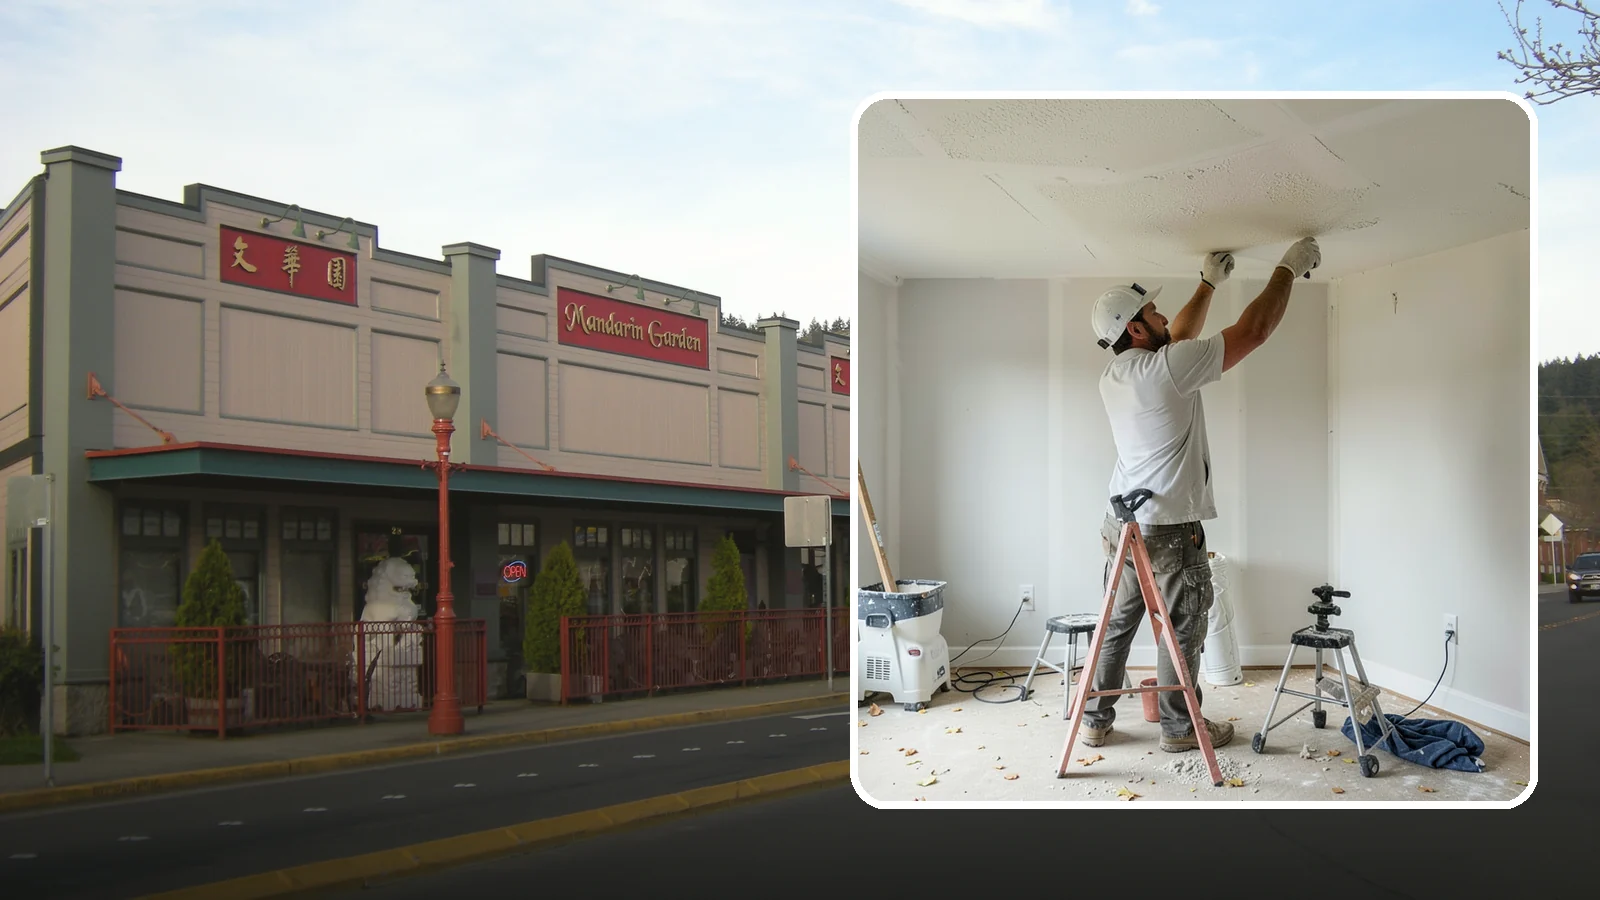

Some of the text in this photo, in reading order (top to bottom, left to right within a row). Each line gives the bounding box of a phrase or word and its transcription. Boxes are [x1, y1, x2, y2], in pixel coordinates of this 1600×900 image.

[231, 236, 346, 291] 文華園
[565, 302, 701, 352] Mandarin Garden
[503, 565, 527, 578] OPEN
